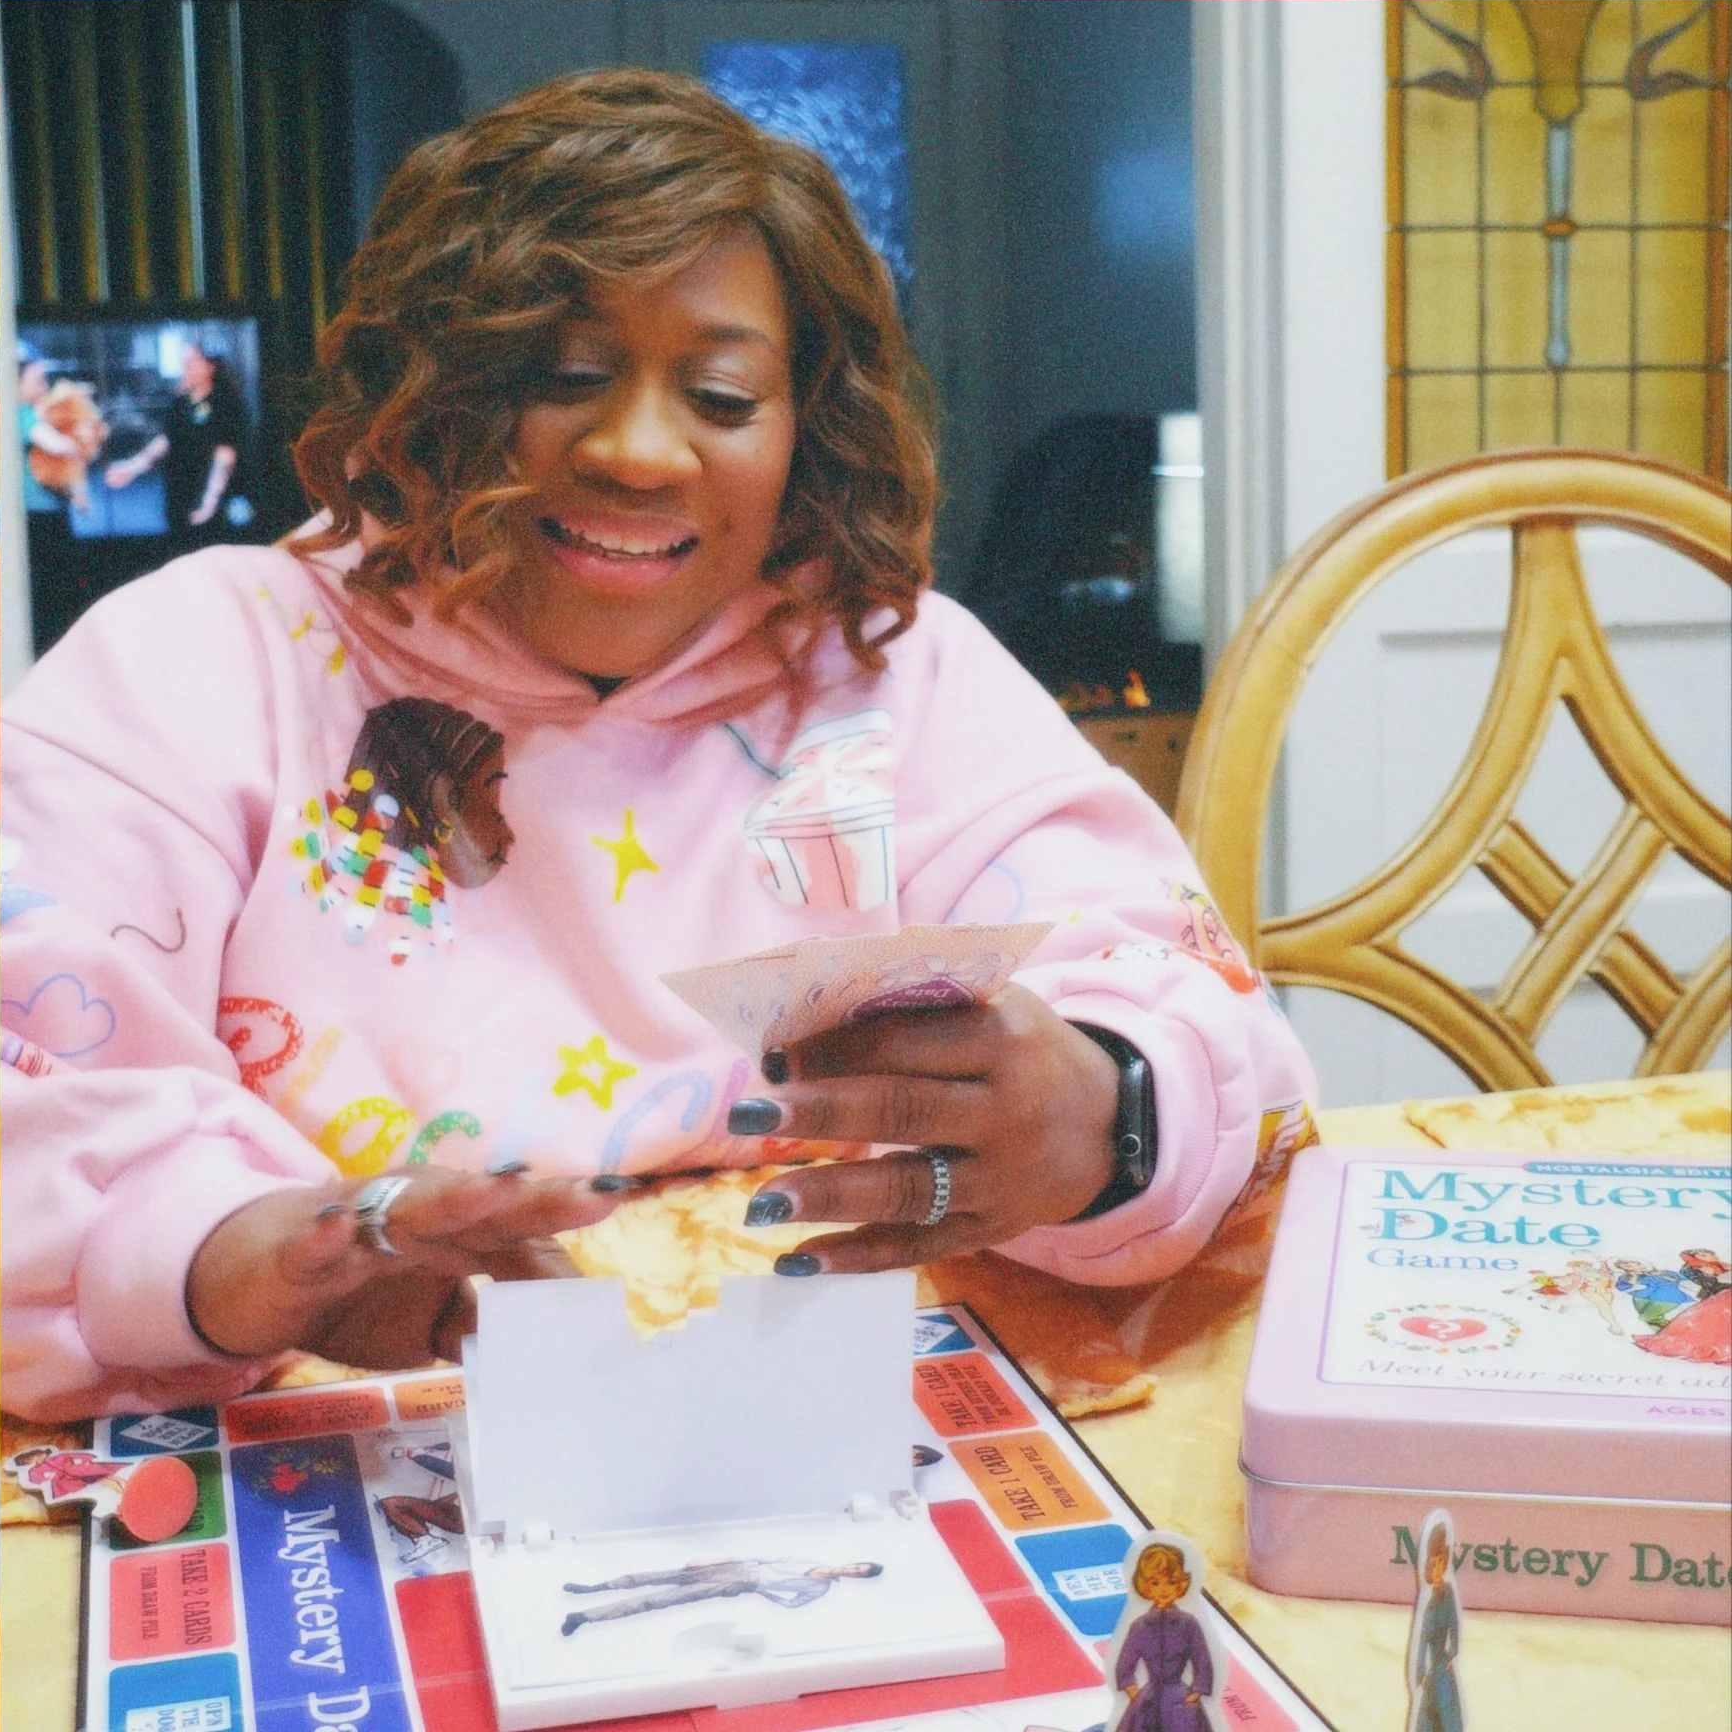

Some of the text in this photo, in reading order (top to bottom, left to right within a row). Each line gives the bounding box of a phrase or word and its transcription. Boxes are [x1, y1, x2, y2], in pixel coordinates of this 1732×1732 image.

[1535, 1163, 1665, 1176] NOSTALGIA
[1370, 1207, 1601, 1248] Date
[1366, 1248, 1519, 1272] Game
[1359, 1359, 1445, 1376] Meet
[1456, 1368, 1547, 1381] your
[1558, 1371, 1667, 1387] secret
[941, 1400, 978, 1428] TAKE
[1648, 1405, 1727, 1417] AGES
[975, 1446, 1013, 1476] CARD
[1019, 1444, 1079, 1509] FROM DRAW PILE
[1004, 1488, 1047, 1521] TAKE
[141, 1566, 159, 1641] FROM DRAW PILE
[181, 1548, 213, 1646] TAKE 2 CARDS
[277, 1504, 346, 1674] Mystery
[1223, 1695, 1257, 1721] FROM
